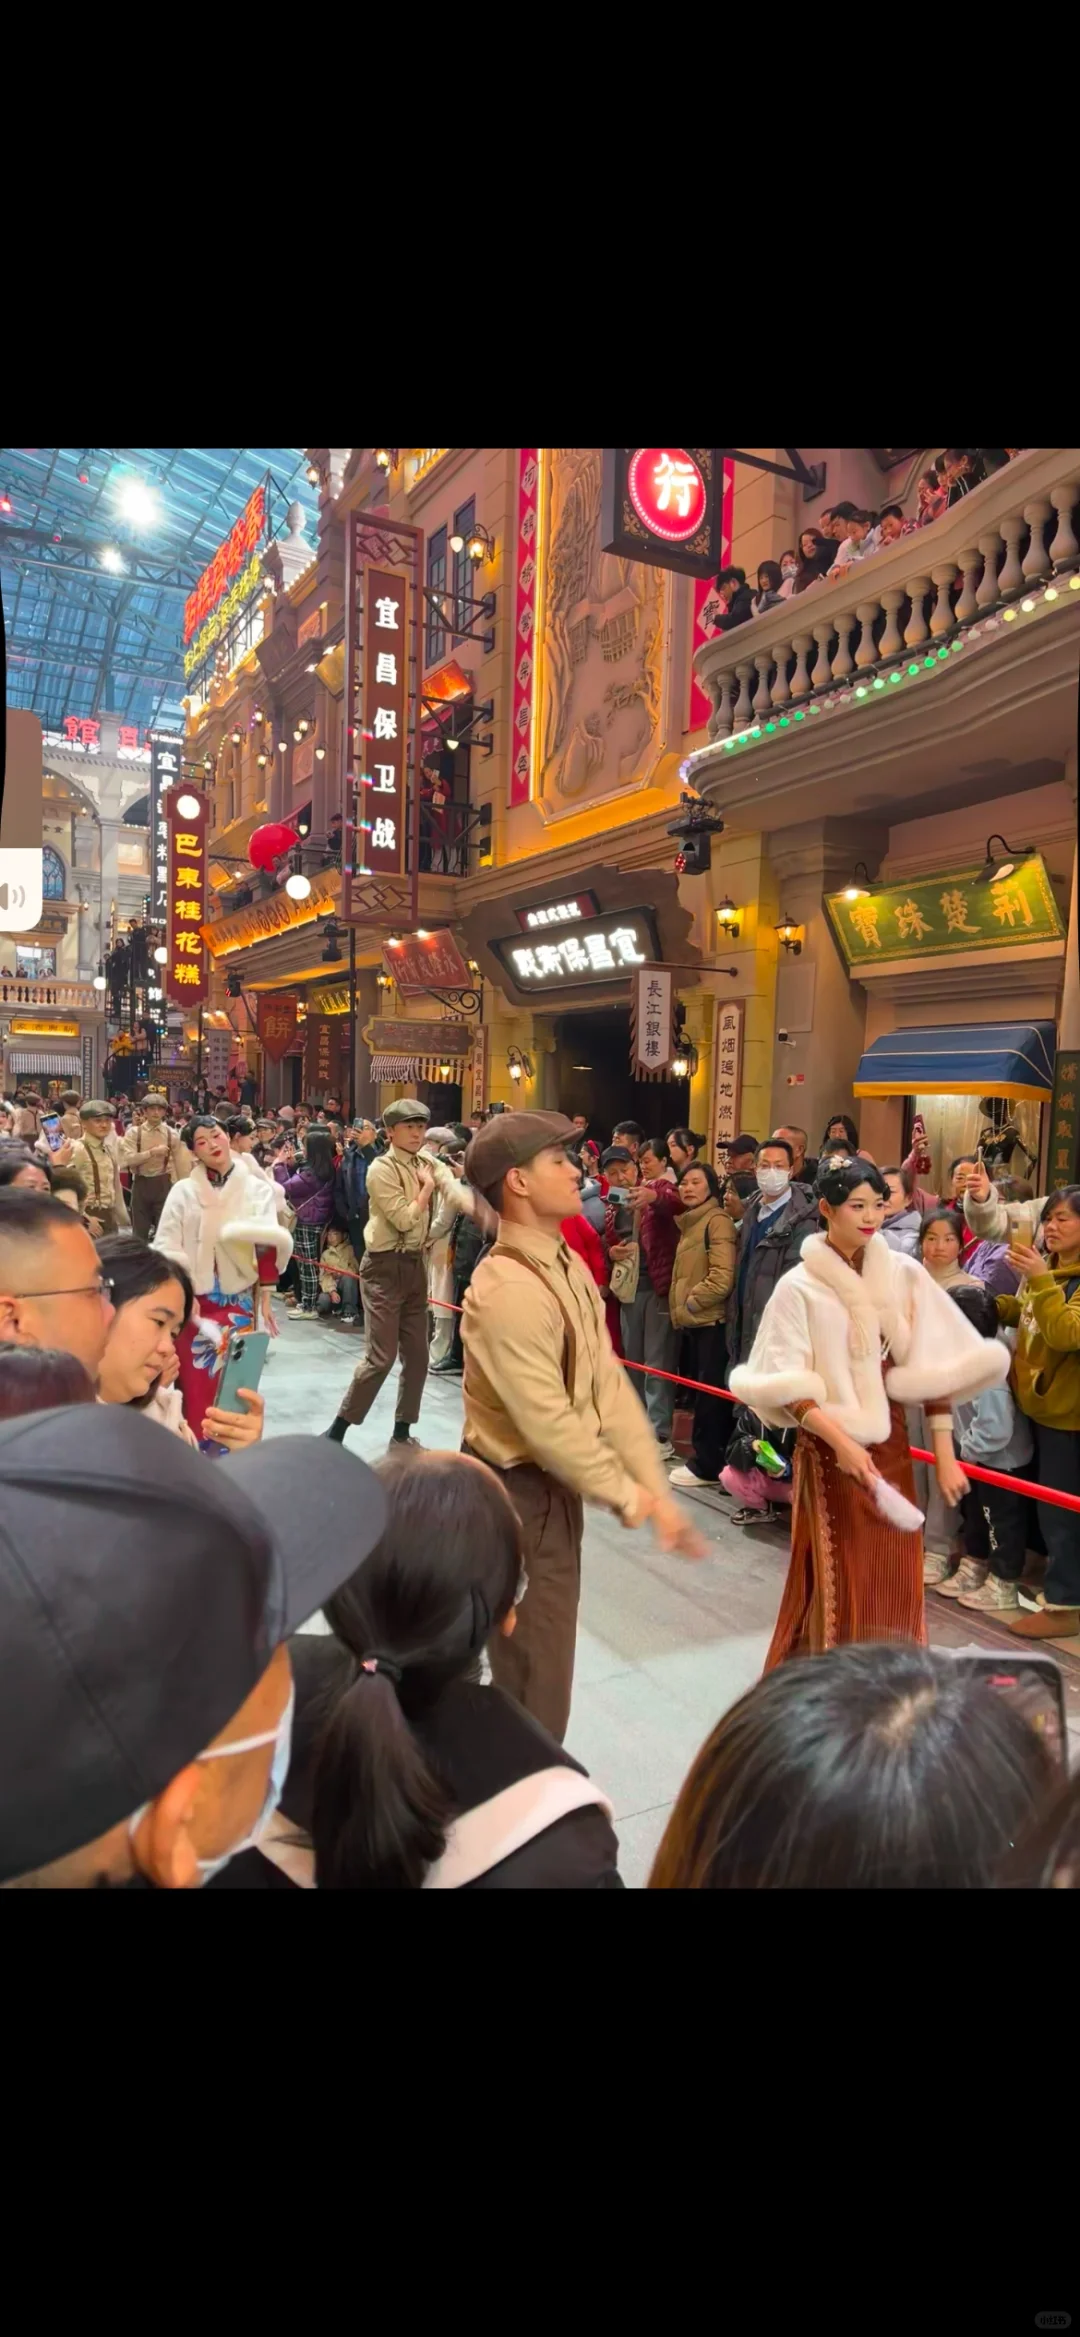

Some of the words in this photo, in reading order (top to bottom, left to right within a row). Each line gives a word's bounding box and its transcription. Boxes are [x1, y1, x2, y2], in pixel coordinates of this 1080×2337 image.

[653, 453, 699, 517] 行
[371, 597, 400, 850] 宜昌保卫战
[174, 833, 202, 986] 巴東桂花糕
[643, 980, 662, 1057] 長江銀樓
